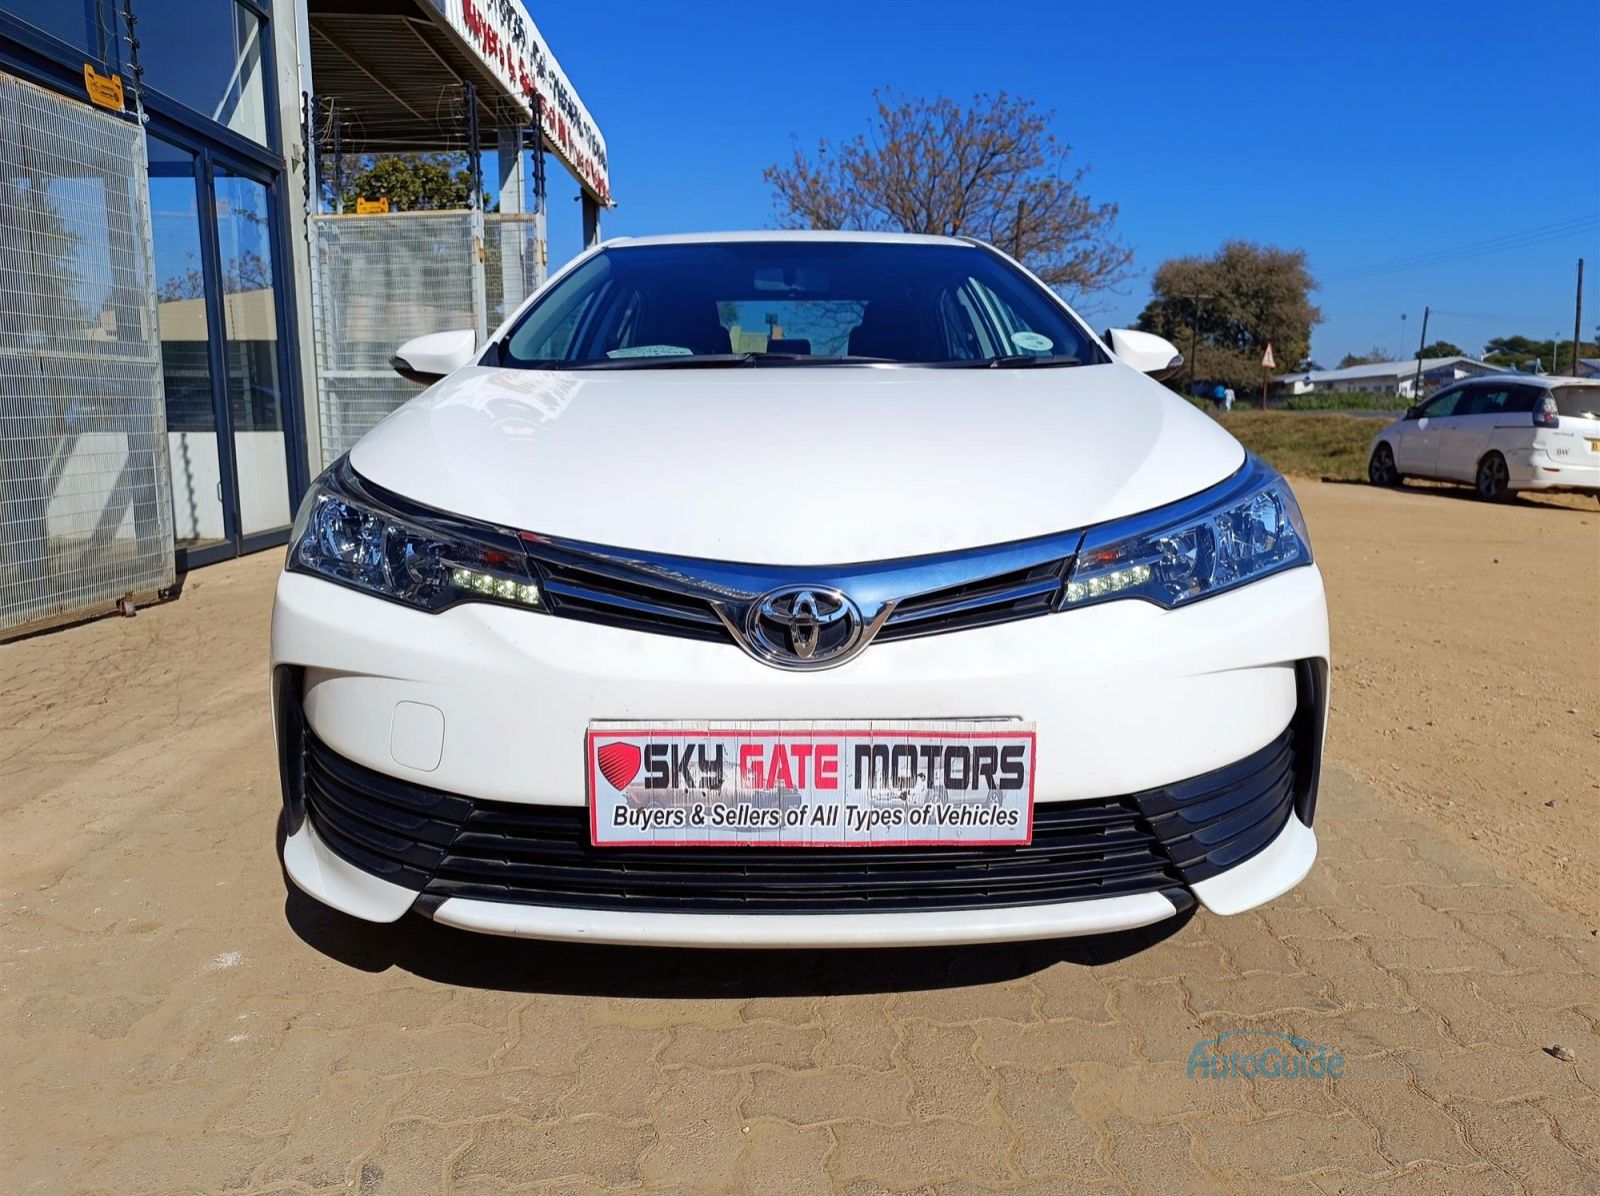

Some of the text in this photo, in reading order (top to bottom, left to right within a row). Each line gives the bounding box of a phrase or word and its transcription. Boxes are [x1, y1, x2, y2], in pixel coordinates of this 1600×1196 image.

[643, 743, 1025, 791] SKY GATE MOTORS
[613, 804, 1019, 830] Buyers & Sellers of All Types of Vehicles
